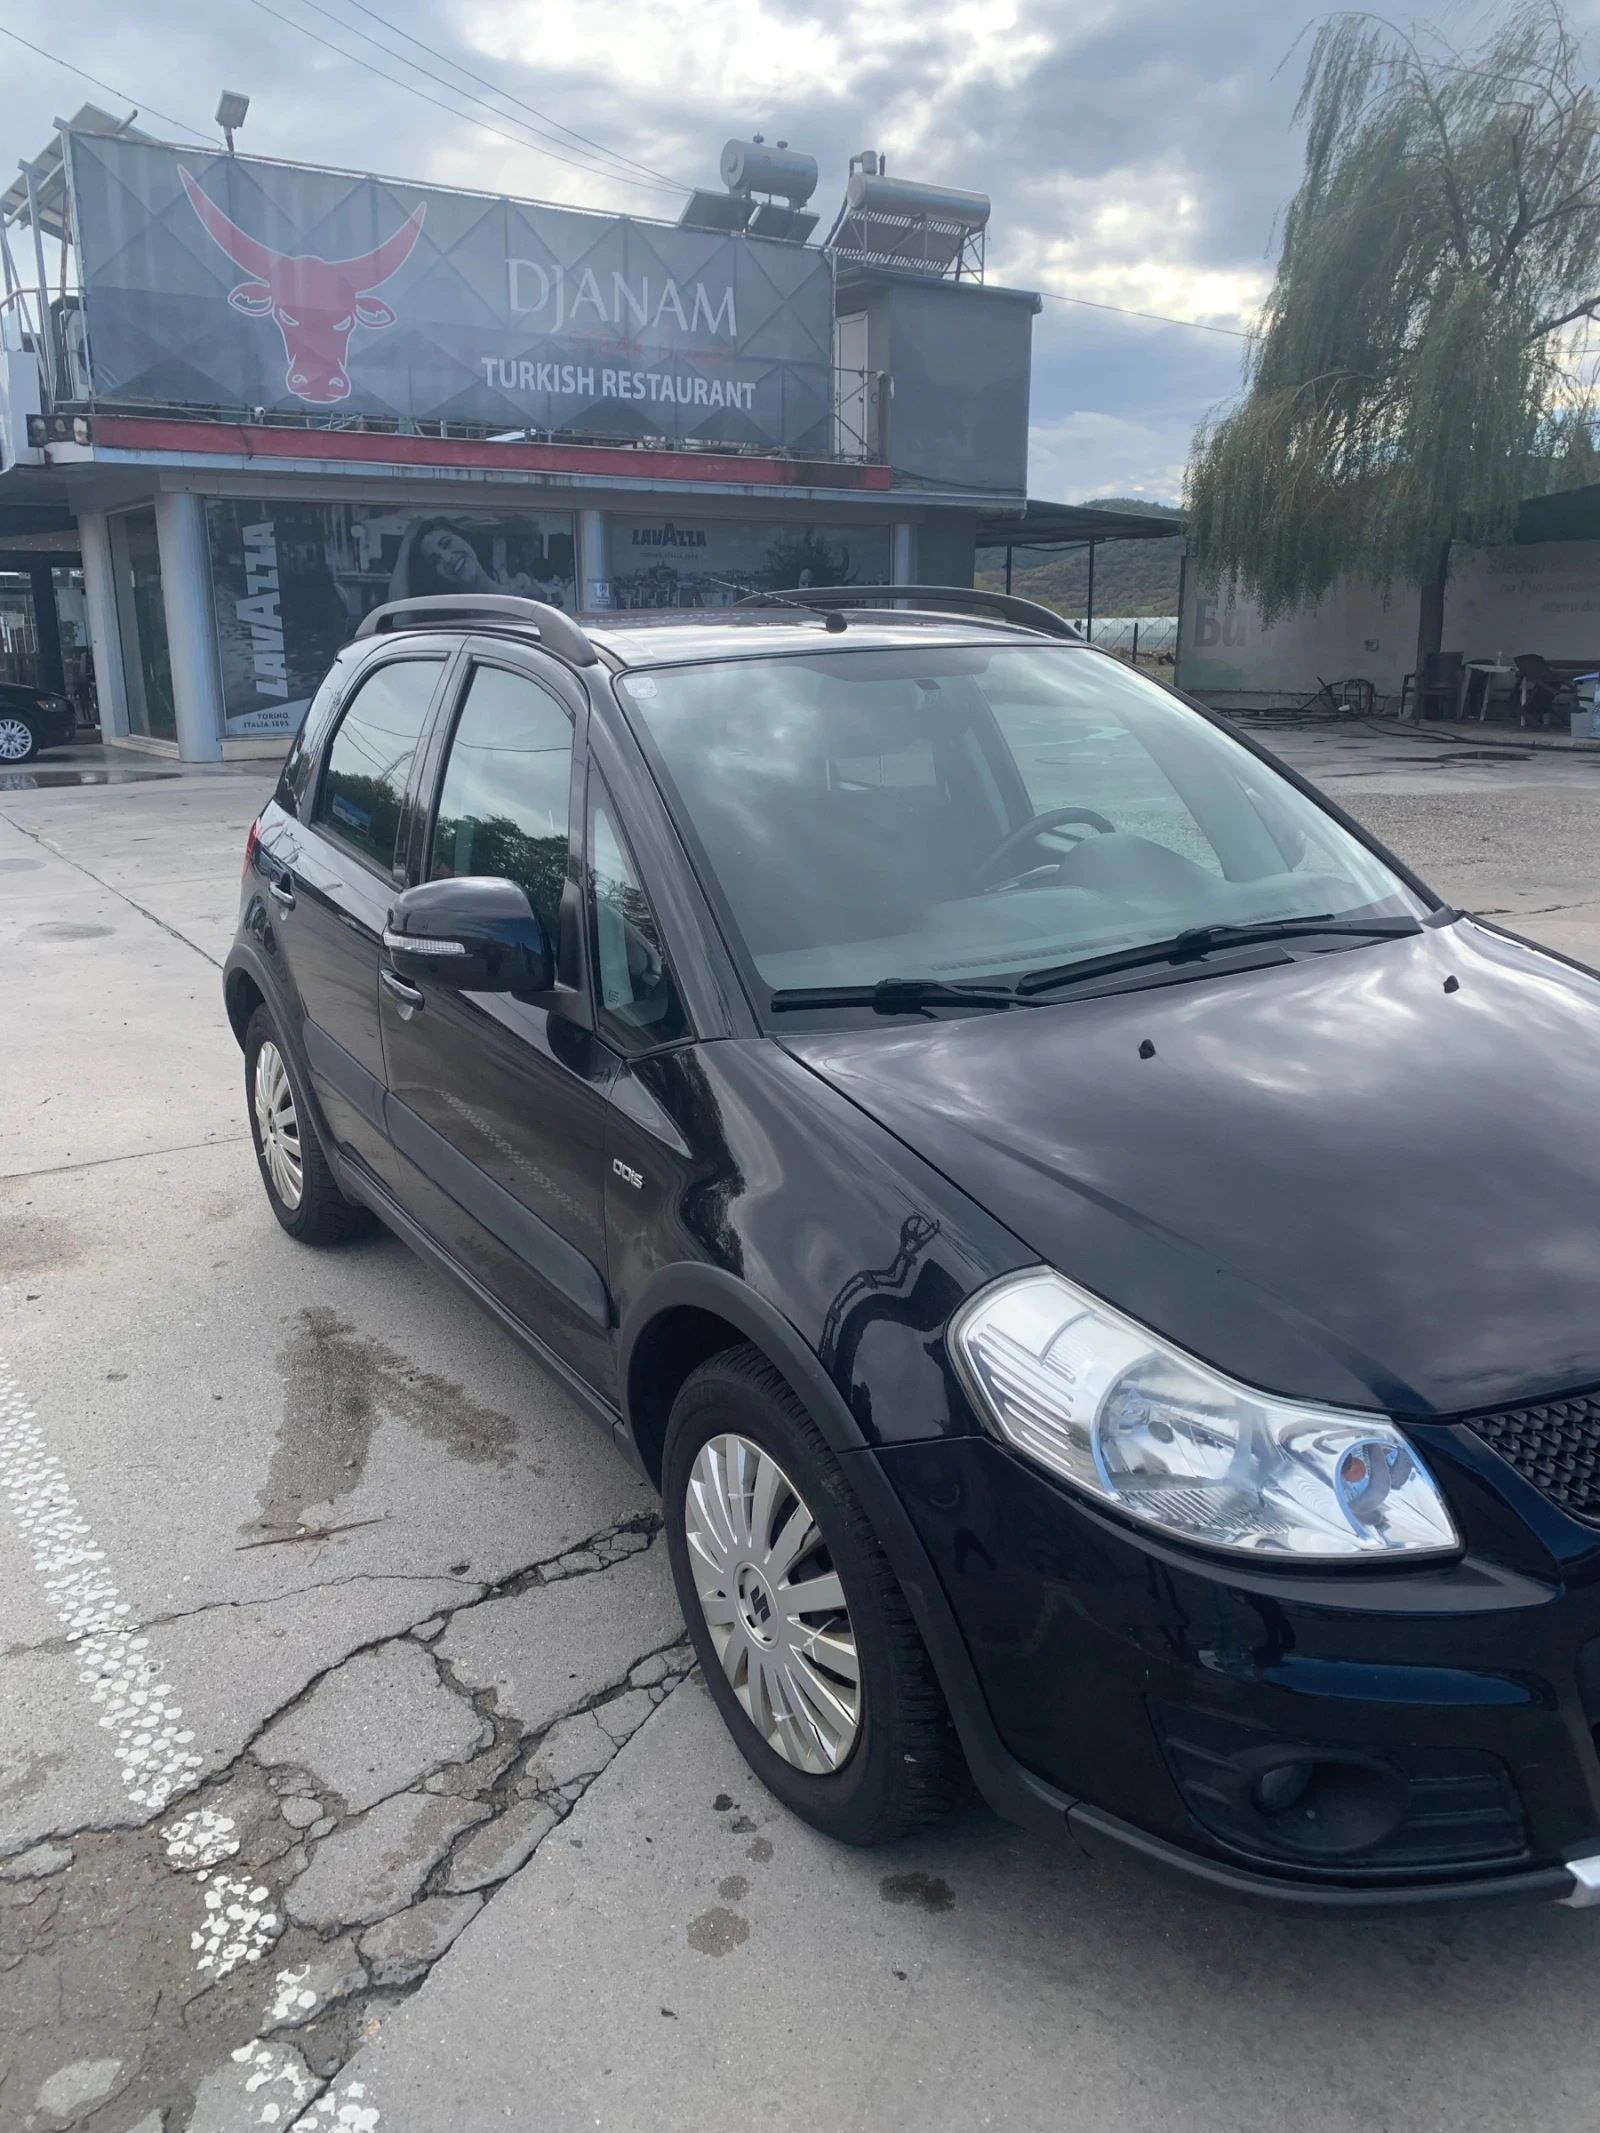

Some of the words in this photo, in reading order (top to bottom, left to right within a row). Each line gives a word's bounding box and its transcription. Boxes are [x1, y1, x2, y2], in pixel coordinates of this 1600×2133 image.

[504, 258, 738, 337] DJANAM
[481, 356, 595, 396] TURKISH
[602, 368, 756, 409] RESTAURANT
[632, 523, 708, 547] LAVAZZA
[235, 521, 289, 698] LAVAZZA
